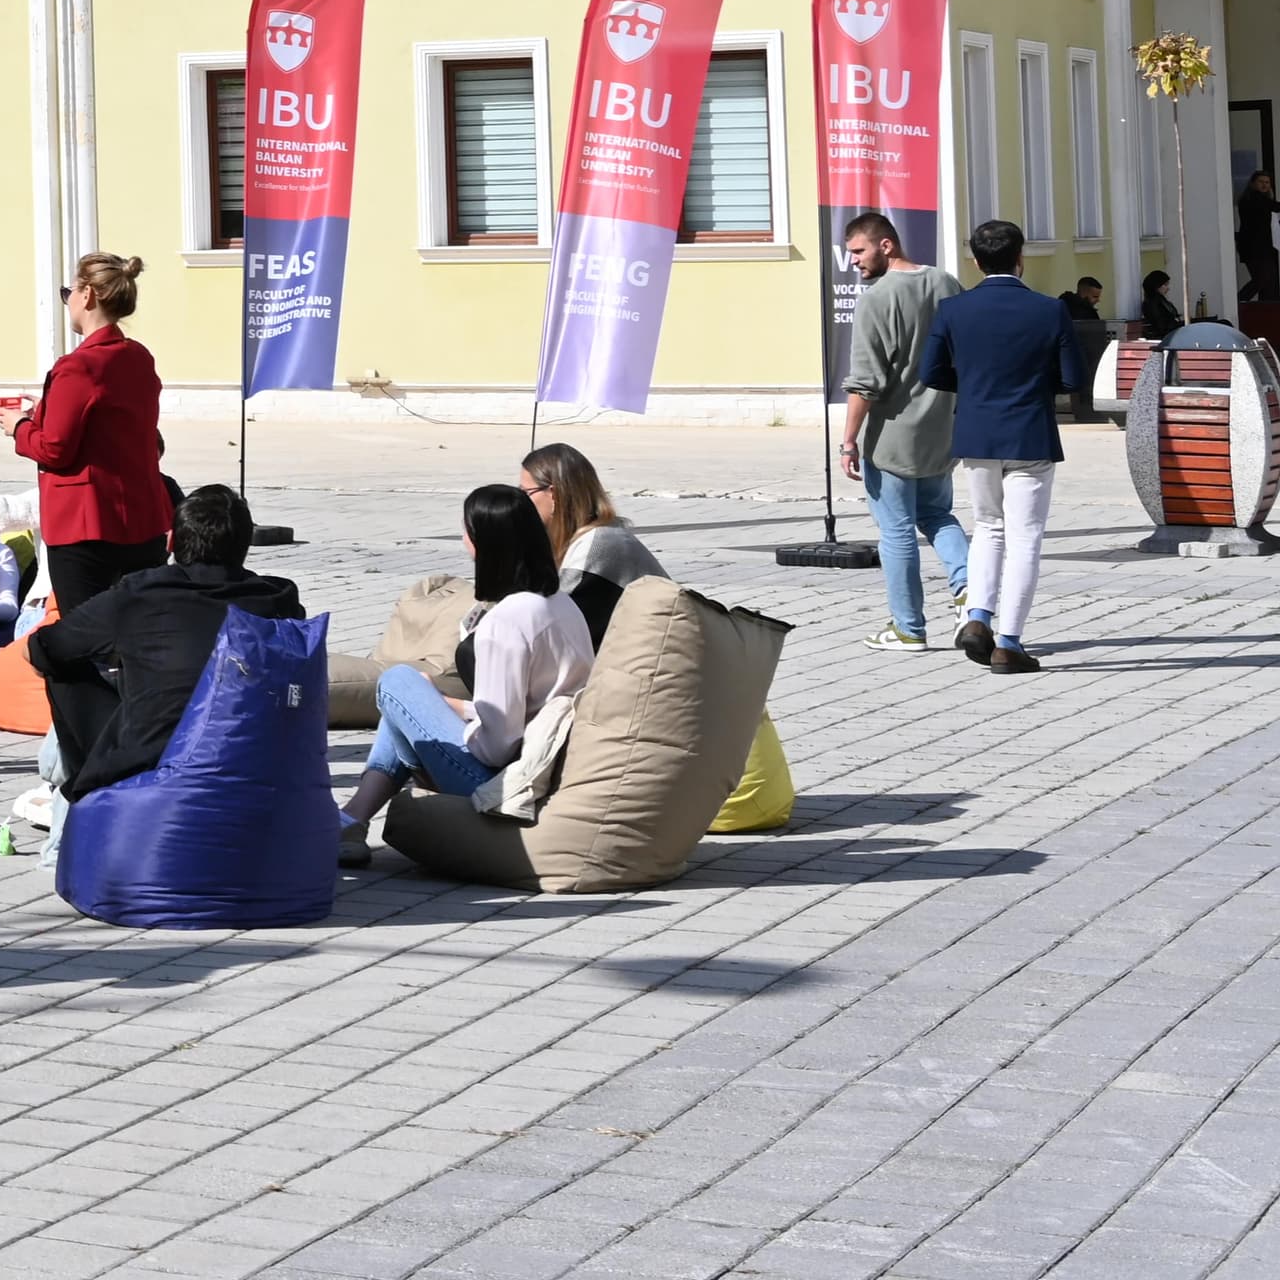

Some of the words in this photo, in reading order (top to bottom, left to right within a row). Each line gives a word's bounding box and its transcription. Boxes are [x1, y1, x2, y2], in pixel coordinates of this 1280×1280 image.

[829, 63, 911, 110] IBU
[258, 87, 333, 131] IBU
[588, 79, 672, 128] IBU
[829, 119, 930, 137] INTERNATIONAL
[256, 138, 348, 152] INTERNATIONAL
[584, 131, 682, 159] INTERNATIONAL
[829, 133, 876, 146] BALKAN
[256, 151, 302, 164] BALKAN
[582, 145, 631, 161] BALKAN
[829, 147, 901, 163] UNIVERSITY
[255, 164, 324, 178] UNIVERSITY
[580, 159, 654, 178] UNIVERSITY
[249, 250, 316, 279] FEAS
[249, 289, 293, 300] FACULTY
[293, 284, 306, 296] OF
[565, 289, 611, 304] FACUL
[248, 296, 305, 313] ECONOMICS
[306, 295, 332, 306] AND
[563, 303, 640, 322] ENGINING
[248, 307, 332, 326] ADMINISTRATIVE
[248, 322, 292, 339] SCIENCES
